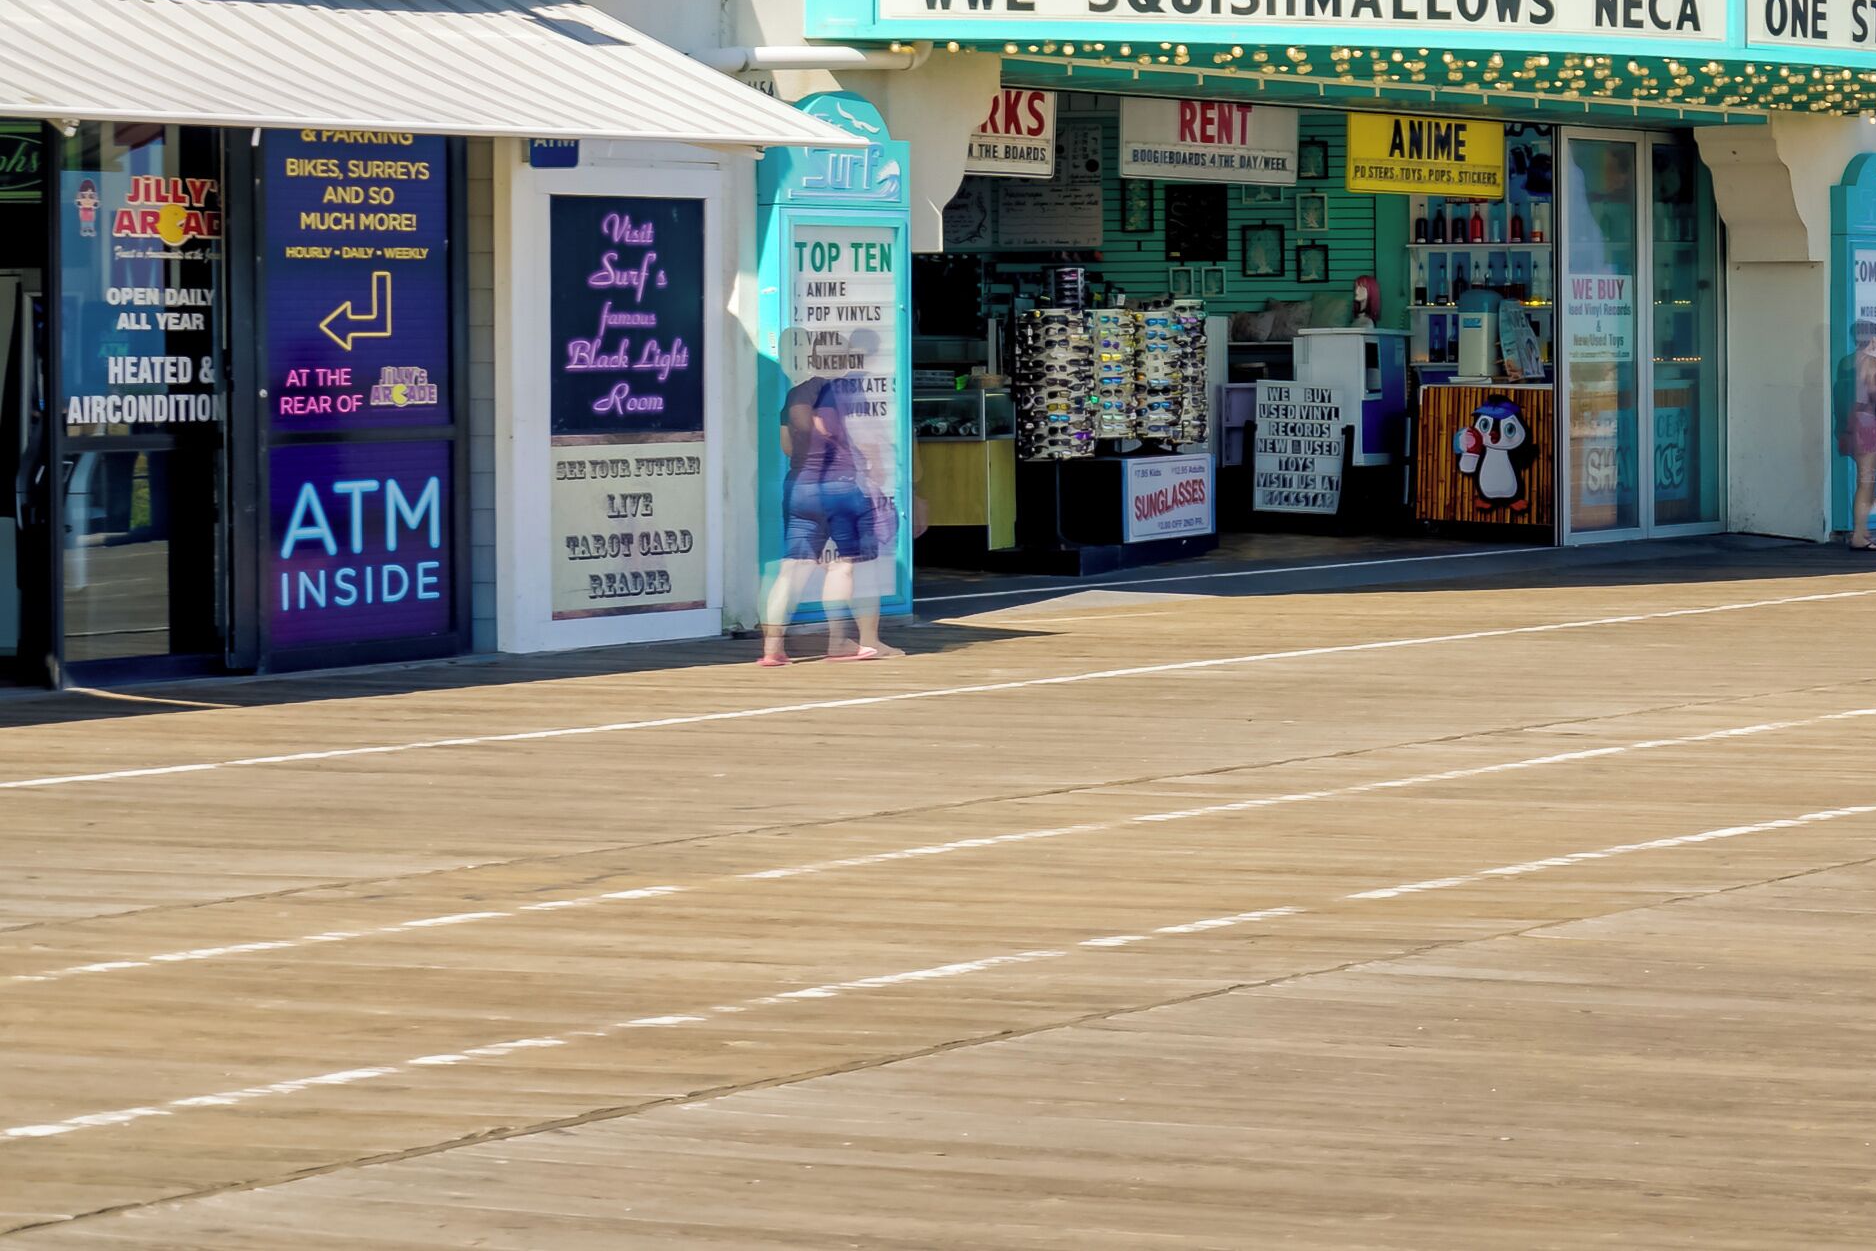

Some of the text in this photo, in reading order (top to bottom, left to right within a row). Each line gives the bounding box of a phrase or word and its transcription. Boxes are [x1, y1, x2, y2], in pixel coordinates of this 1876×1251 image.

[1178, 100, 1253, 145] RENT
[1389, 119, 1468, 162] ANIME
[978, 144, 1046, 162] THE BOARDS
[1132, 148, 1288, 171] BOOGIEBOARDS 4 THE DAY/WEEK
[285, 158, 430, 180] BIKES, SURREYS
[323, 186, 394, 205] AND SO
[300, 212, 417, 231] MUCH MORE!
[602, 213, 654, 243] Visit
[285, 246, 429, 259] HOURLY DAILY WEEKLY
[795, 241, 892, 273] TOP TEN
[106, 288, 215, 306] OPEN DAILY
[807, 281, 847, 297] ANIME
[1572, 278, 1624, 300] WE BUY
[807, 306, 881, 322] POP VINYLS
[1585, 303, 1631, 317] Vinyl Records
[1860, 306, 1876, 317] MORE
[116, 313, 205, 331] ALL YEAR
[599, 301, 657, 340] famous
[807, 331, 843, 347] VINYL
[1608, 334, 1624, 347] Toys
[565, 338, 689, 381] Black Light
[807, 354, 865, 370] POKEMON
[107, 356, 215, 384] HEATED &
[286, 369, 352, 387] AT THE
[593, 383, 665, 415] Room
[1268, 387, 1332, 403] WE BUY
[280, 395, 364, 415] REAR OF
[1259, 404, 1340, 421] USED VINYL
[1268, 421, 1331, 438] RECORDS
[1257, 438, 1289, 454] NEW
[1305, 440, 1340, 456] USED
[556, 456, 701, 480] SEE YOUR FUTURE!
[1279, 457, 1316, 473] TOYS
[1257, 474, 1340, 491] VISIT US AT
[607, 492, 653, 518] LIVE
[1134, 478, 1206, 522] SUNGLASSES
[281, 476, 440, 559] ATM
[566, 529, 693, 560] TAROT CARD
[281, 561, 440, 611] INSIDE
[588, 569, 672, 599] READER
